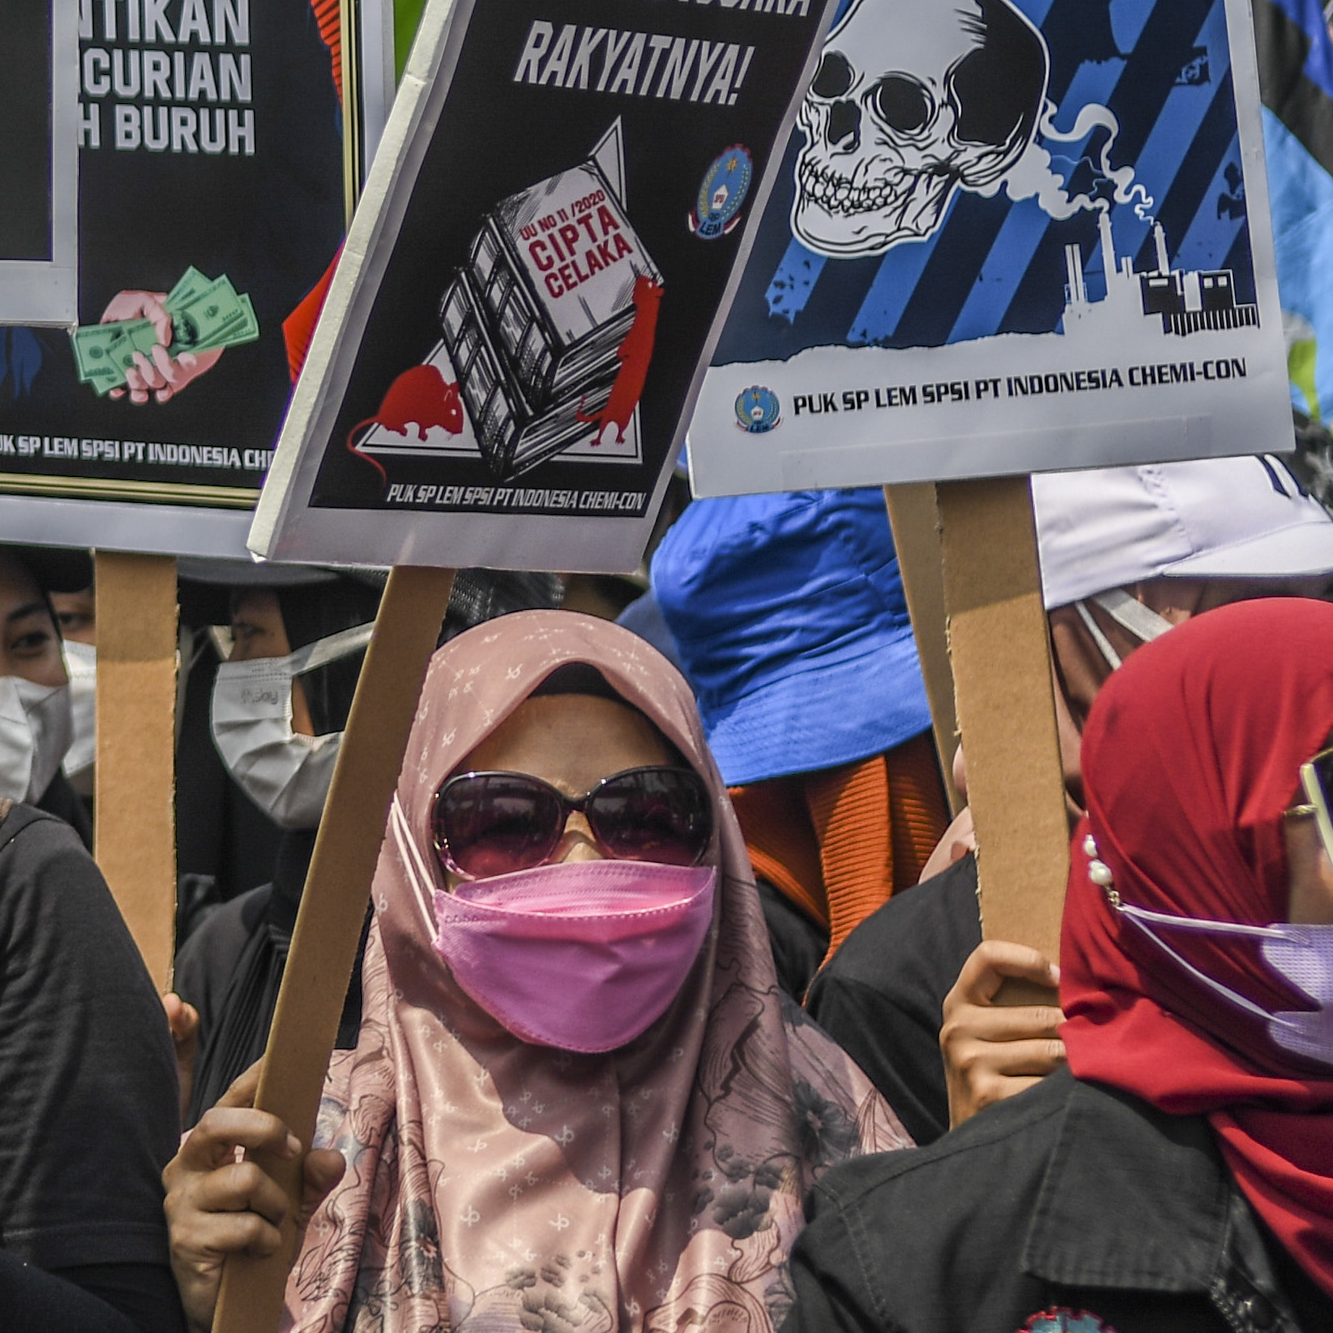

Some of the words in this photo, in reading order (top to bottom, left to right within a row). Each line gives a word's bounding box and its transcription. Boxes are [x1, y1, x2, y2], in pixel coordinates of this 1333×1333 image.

[83, 47, 252, 103] CURIAN
[514, 21, 750, 106] RAKYATNYA!
[115, 103, 256, 156] BURUH
[519, 226, 538, 242] UU
[539, 215, 557, 232] NO
[529, 205, 620, 272] CIPTA
[699, 220, 722, 236] LEM
[544, 233, 633, 299] CELAKA
[793, 393, 838, 415] PUK
[842, 391, 870, 411] SP
[875, 385, 918, 409] LEM
[922, 380, 970, 404] SPSI
[975, 378, 1001, 400] PT
[1007, 368, 1123, 396] INDONESIA
[1128, 358, 1248, 387] CHEMI-CON
[18, 436, 42, 456] SP
[43, 437, 79, 458] LEM
[82, 439, 121, 461] SPSI
[124, 440, 146, 462] PT
[148, 443, 241, 467] INDONESIA
[387, 483, 415, 502] PUK
[415, 485, 434, 503] SP
[435, 486, 462, 504] LEM
[462, 487, 494, 505] SPSI
[493, 488, 512, 506] PT
[511, 488, 579, 508] INDONESIA
[579, 491, 647, 510] CHEMI-CON
